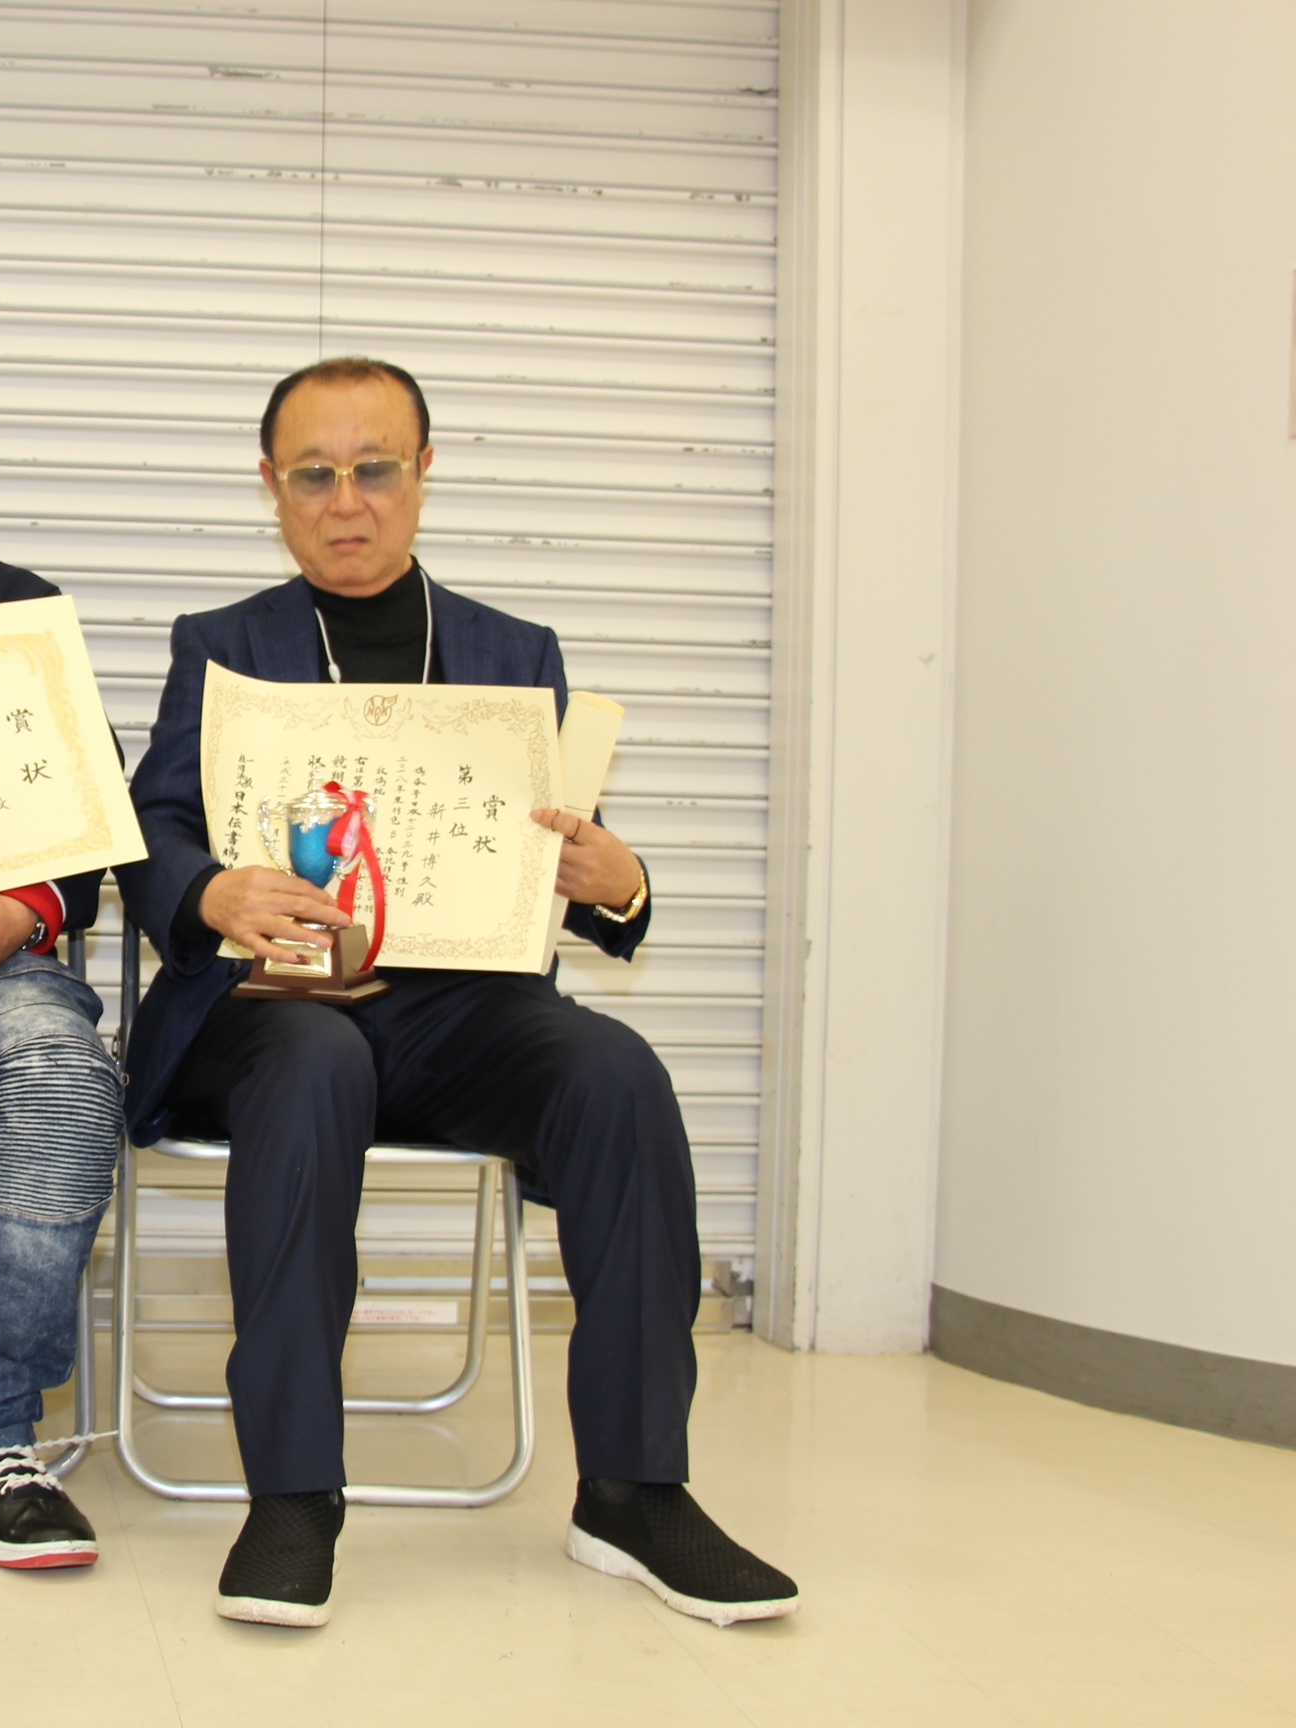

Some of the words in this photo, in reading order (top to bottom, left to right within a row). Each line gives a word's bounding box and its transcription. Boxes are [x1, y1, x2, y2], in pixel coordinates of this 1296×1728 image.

[6, 708, 53, 784] 賞状
[449, 764, 473, 837] 第三位
[472, 794, 506, 854] 賞状
[411, 802, 445, 907] 新井博久殿
